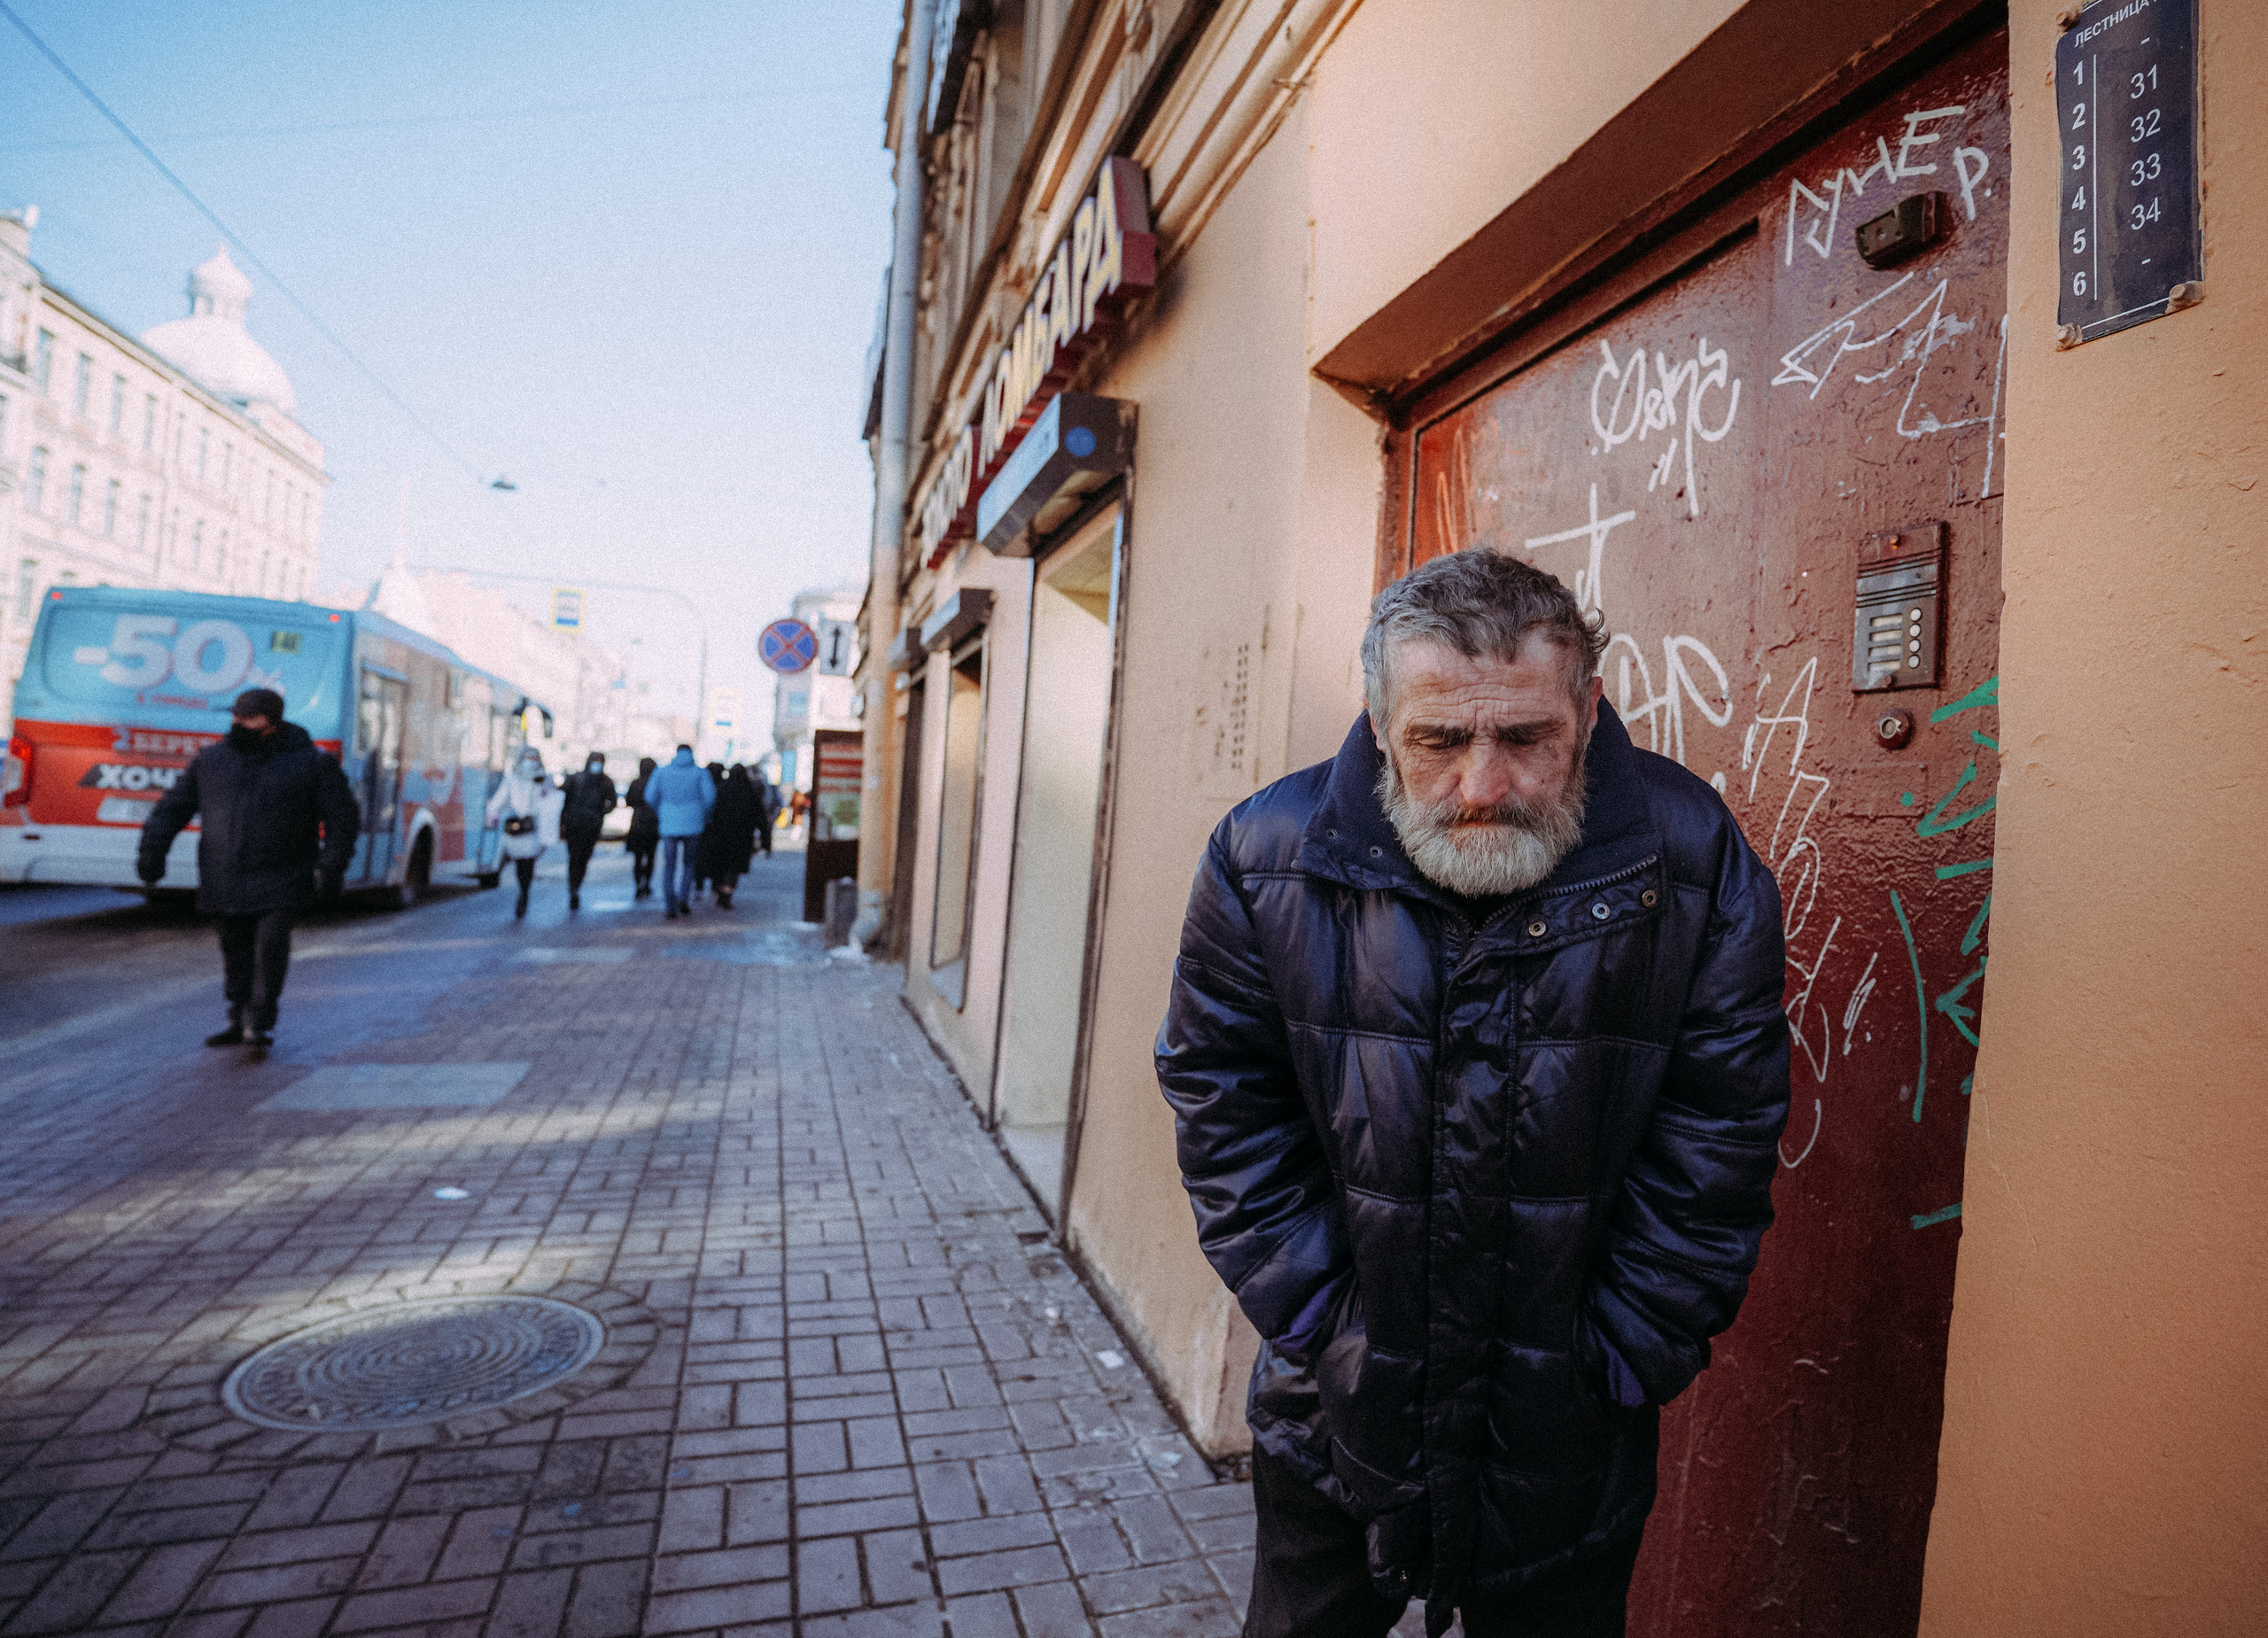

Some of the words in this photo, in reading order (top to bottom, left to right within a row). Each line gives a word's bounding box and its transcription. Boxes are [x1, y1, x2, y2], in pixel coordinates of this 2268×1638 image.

[2071, 103, 2085, 130] 2
[2130, 64, 2158, 99] 31
[2073, 61, 2084, 86] 1
[2072, 145, 2085, 170] 3
[2130, 109, 2161, 142] 32
[2071, 187, 2086, 211] 4
[2130, 153, 2162, 187] 33
[2072, 229, 2085, 254] 5
[2130, 197, 2162, 230] 34
[2072, 272, 2086, 297] 6
[977, 156, 1124, 479] ЛОМБАРД
[97, 764, 185, 791] ХОЧ
